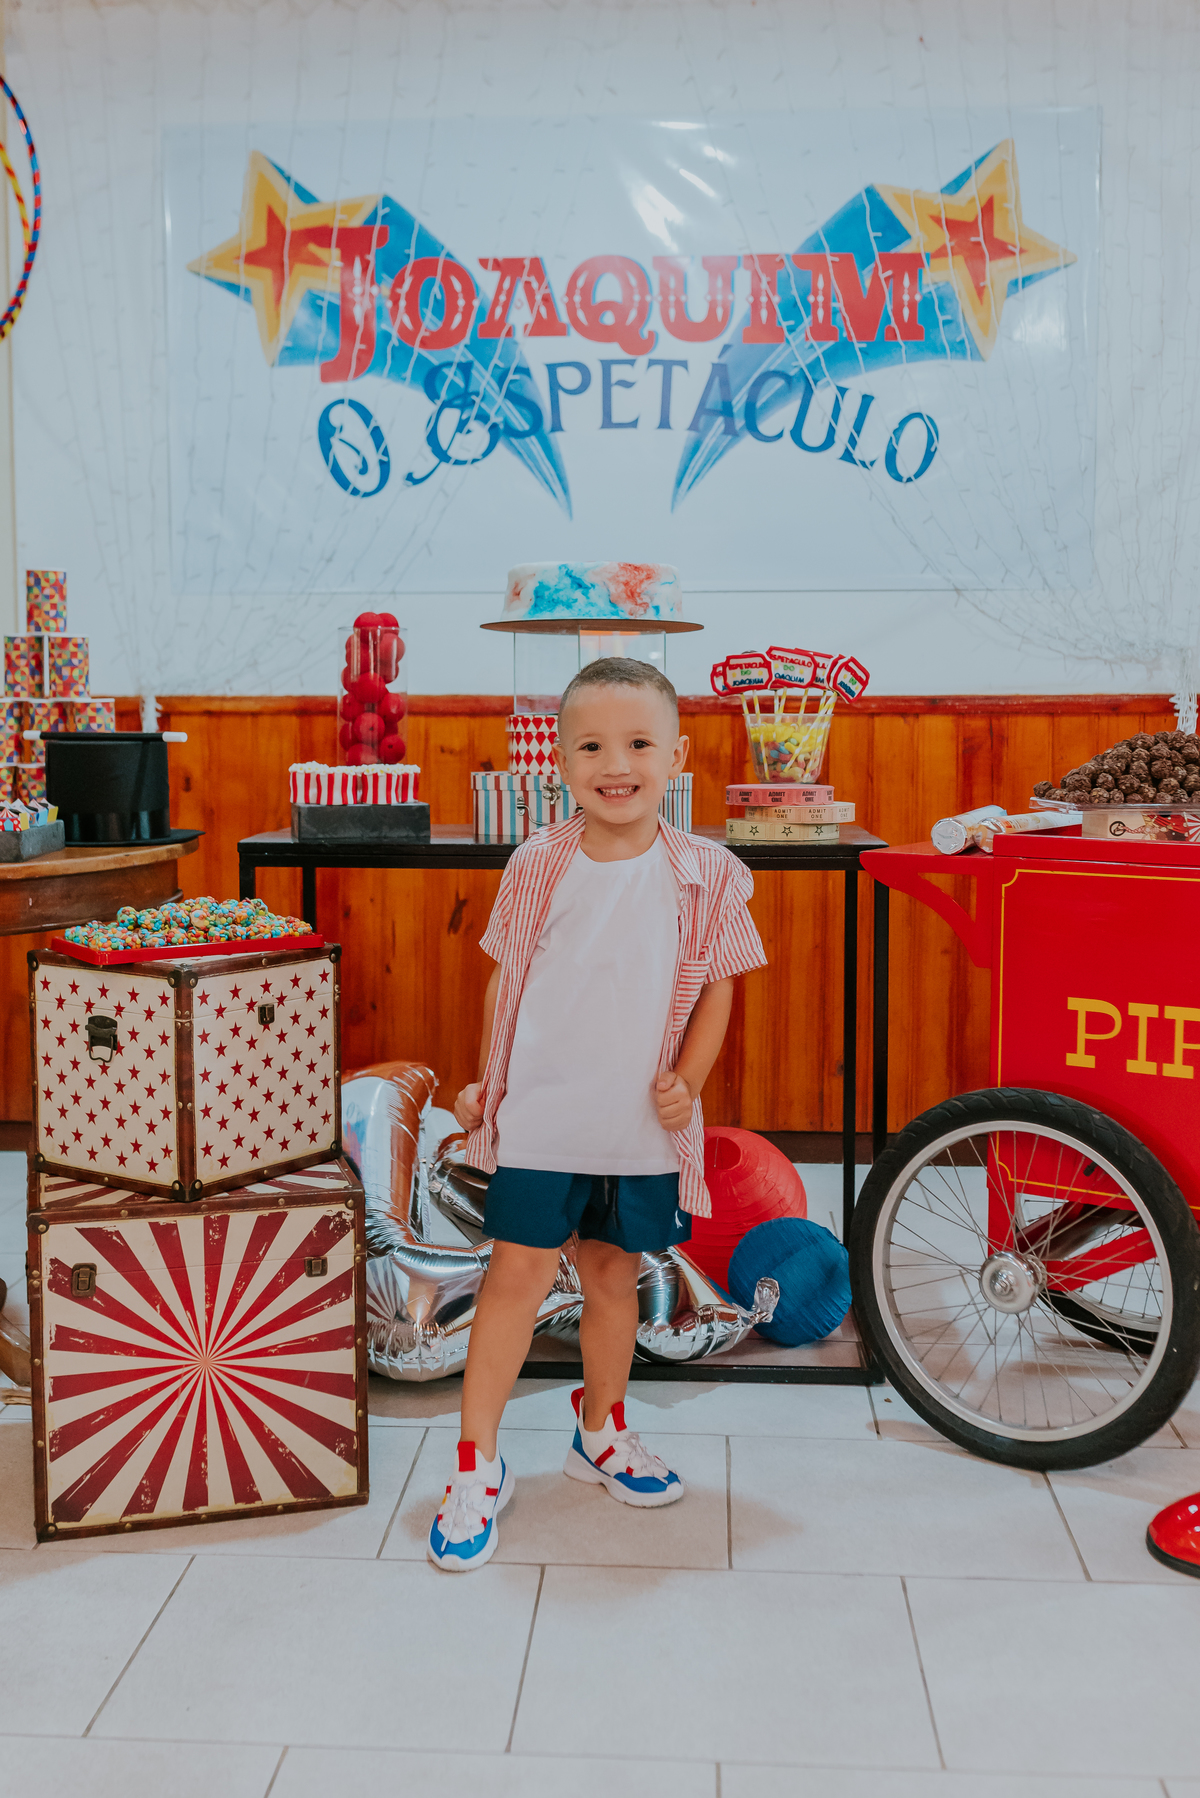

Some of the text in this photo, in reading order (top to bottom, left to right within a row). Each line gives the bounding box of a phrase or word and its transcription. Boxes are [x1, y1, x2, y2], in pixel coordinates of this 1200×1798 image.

[303, 225, 930, 383] JOAQUIM
[318, 344, 939, 498] O ESPETÁCULO
